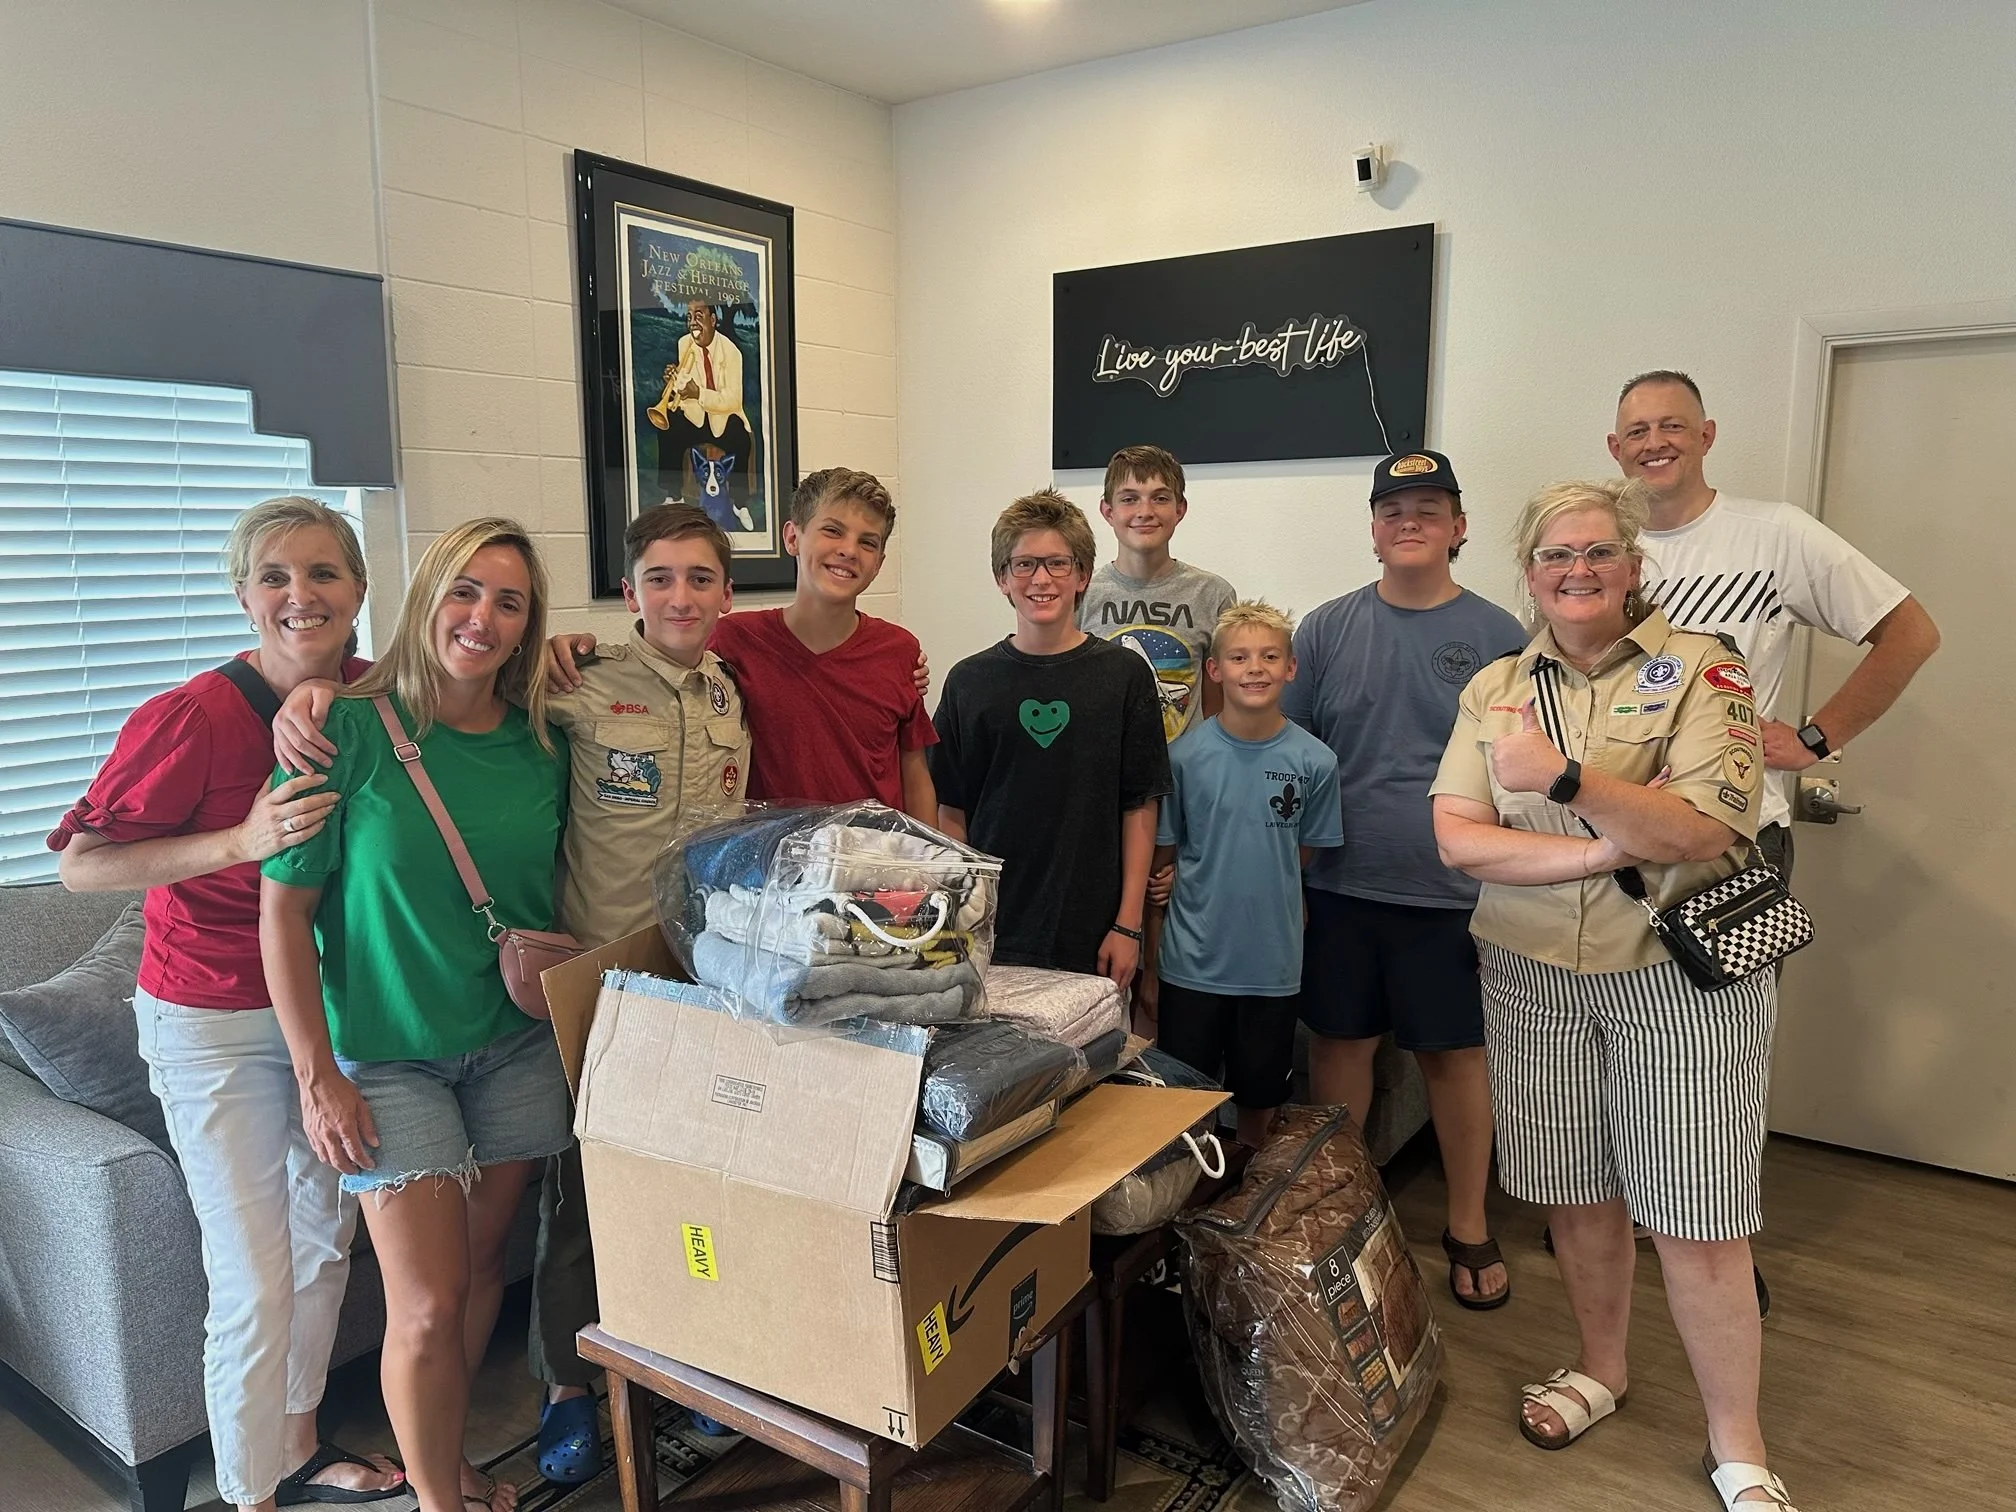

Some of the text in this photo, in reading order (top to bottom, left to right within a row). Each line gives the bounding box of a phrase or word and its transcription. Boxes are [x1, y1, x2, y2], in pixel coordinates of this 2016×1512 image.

[649, 244, 743, 276] NEW ORLEANS
[642, 259, 749, 292] JAZZ & HERITAGE
[1097, 318, 1361, 391] Live your best life
[1101, 600, 1193, 628] NASA
[626, 704, 650, 715] BSA
[1727, 701, 1754, 727] 407
[1264, 771, 1297, 783] TROOP
[689, 1226, 711, 1277] HEAVY
[1328, 1258, 1340, 1277] 8
[1327, 1273, 1351, 1300] piece
[1013, 1290, 1034, 1316] prime
[922, 1310, 944, 1364] HEAVY
